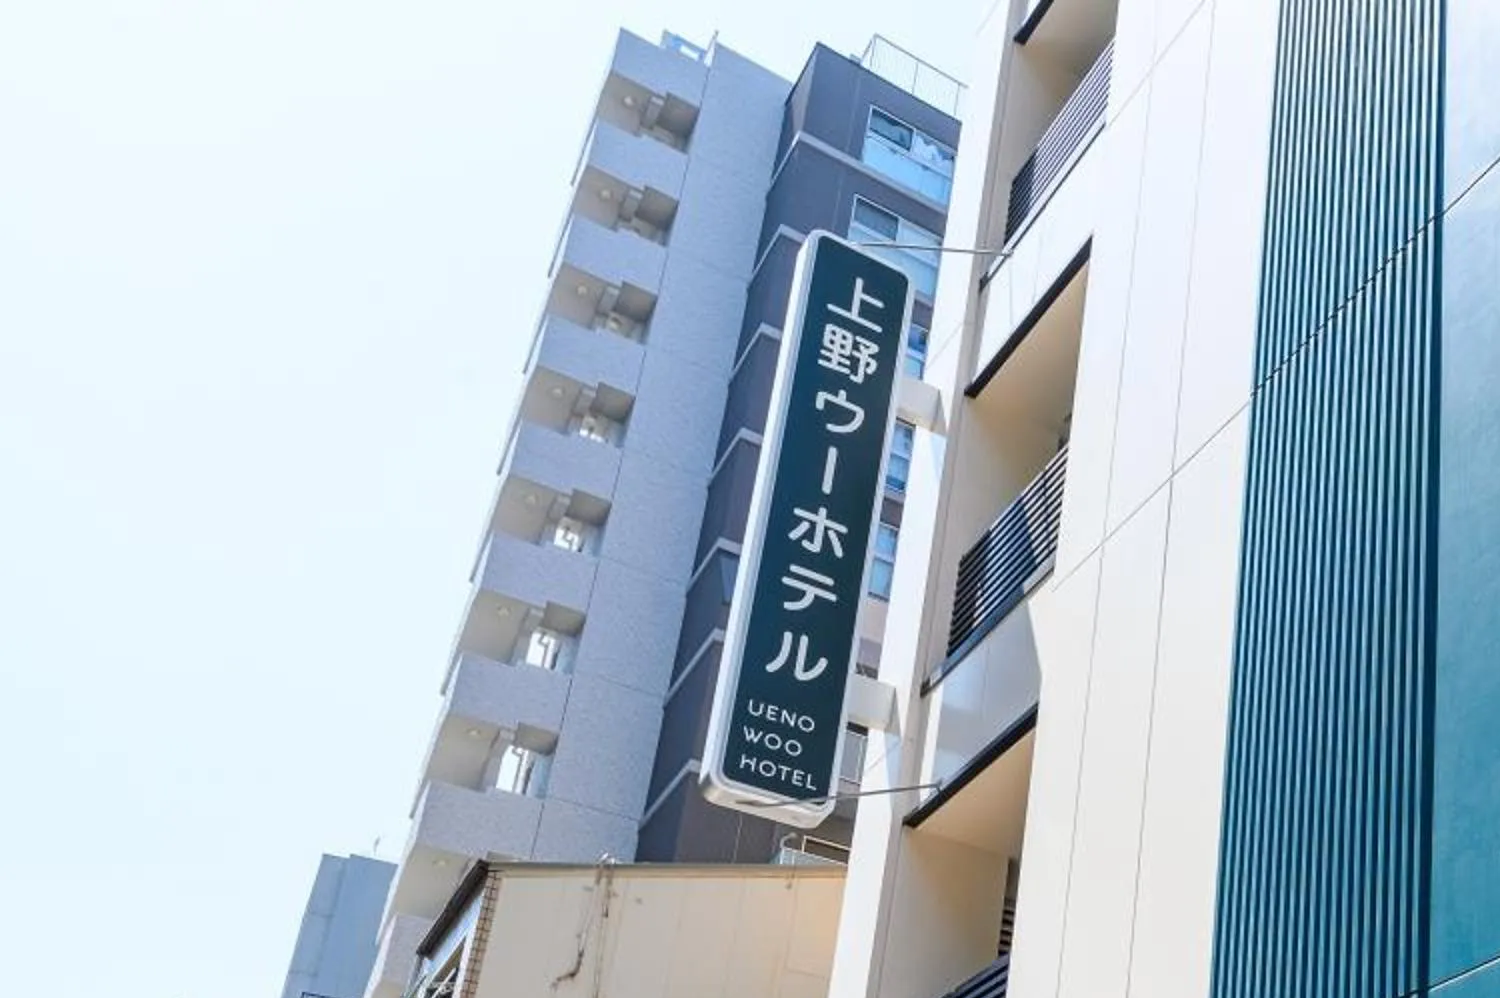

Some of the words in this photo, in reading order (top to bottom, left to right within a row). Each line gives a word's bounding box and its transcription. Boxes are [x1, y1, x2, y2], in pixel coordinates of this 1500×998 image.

[766, 276, 885, 682] 上野ウーホテル
[747, 698, 816, 733] UENO
[742, 724, 804, 758] WOO
[739, 752, 819, 792] HOTEL
